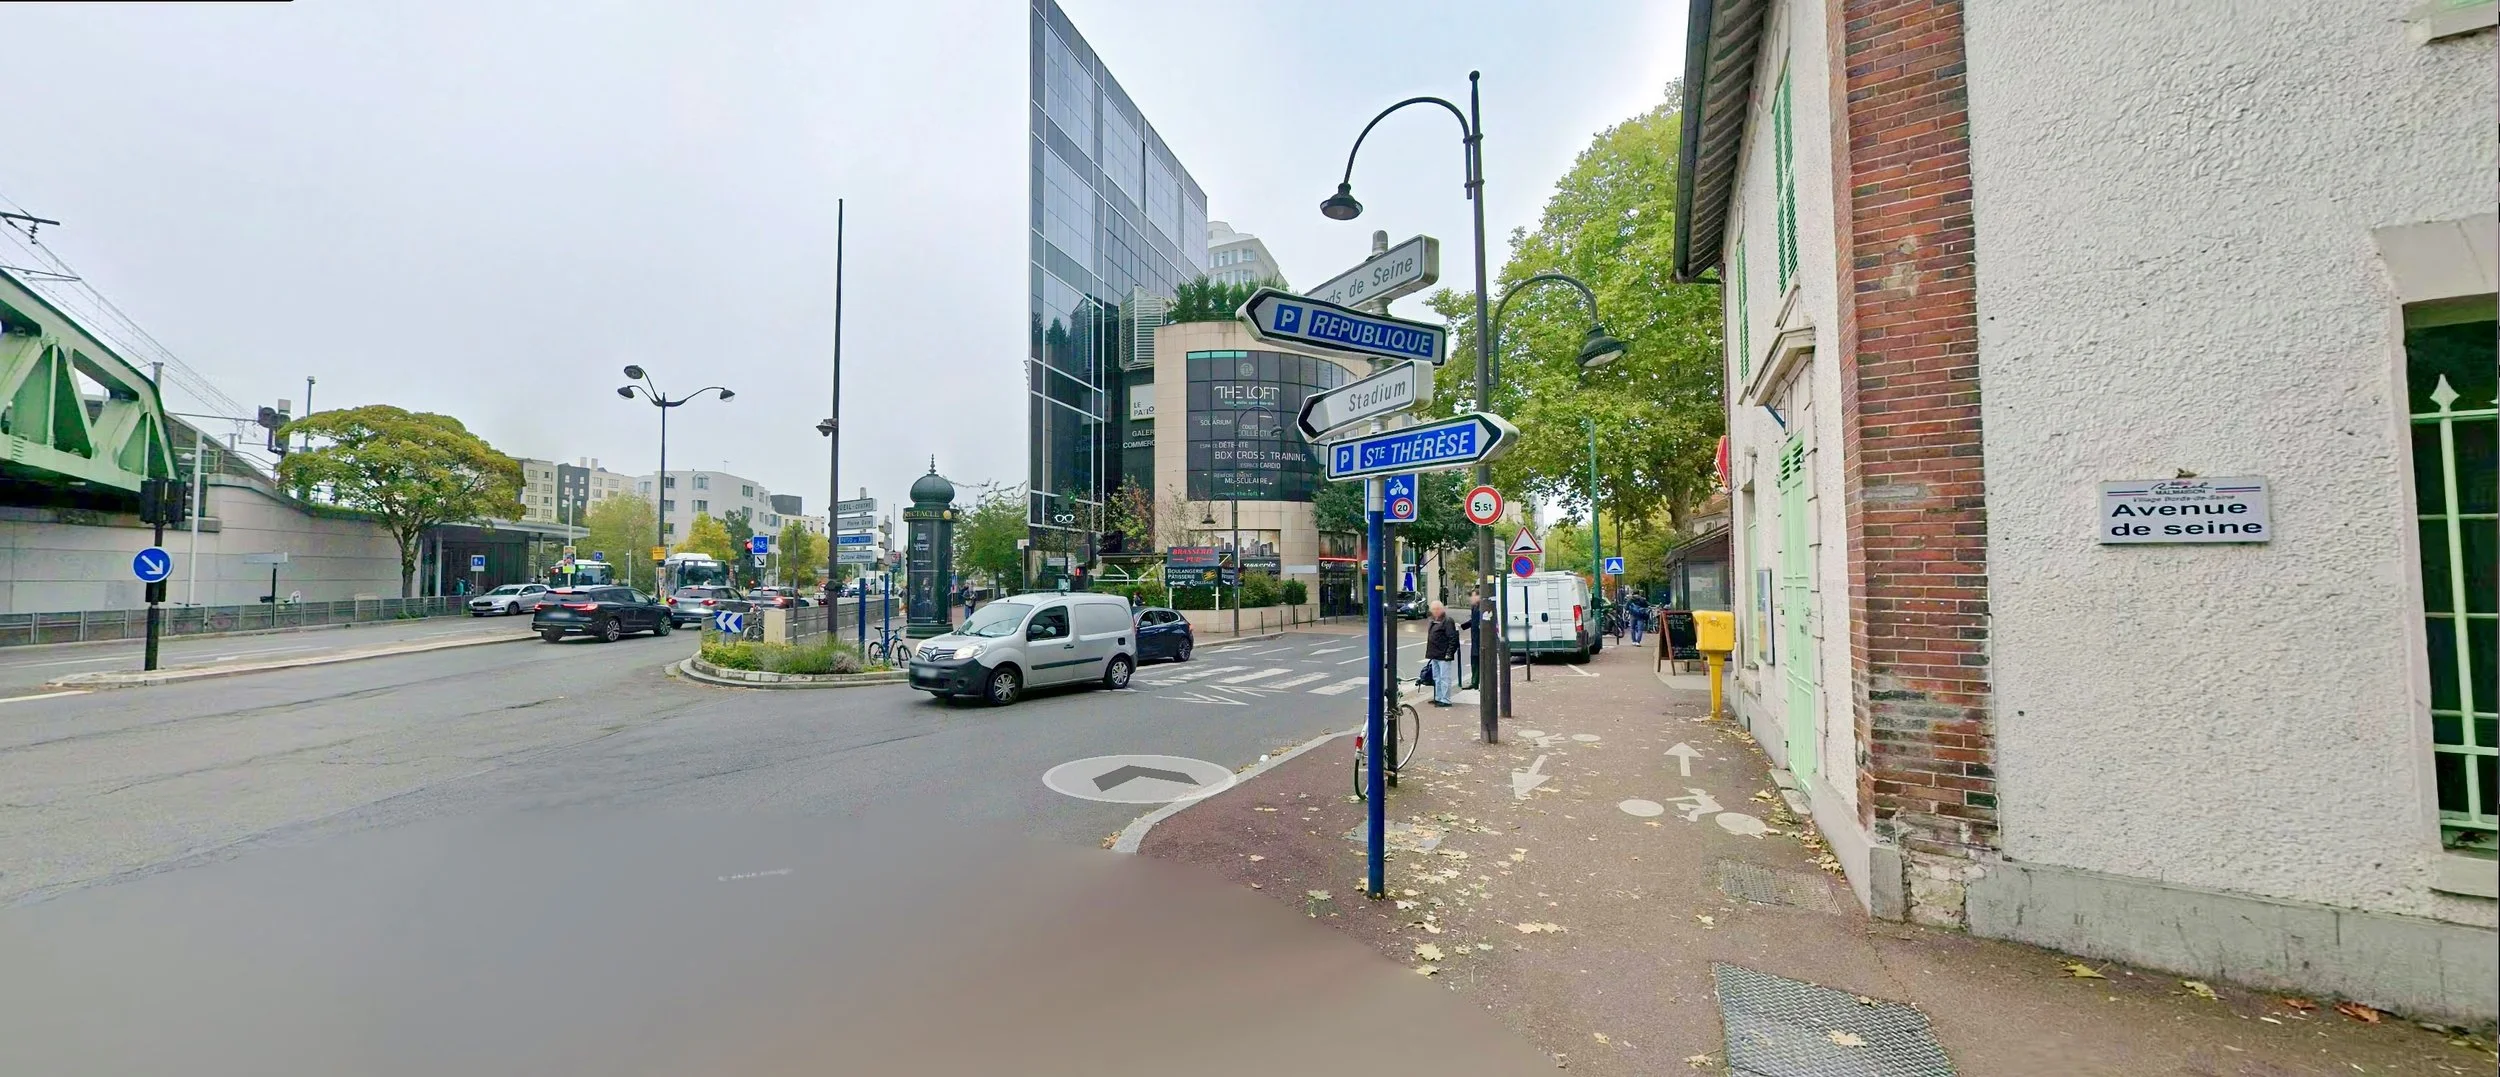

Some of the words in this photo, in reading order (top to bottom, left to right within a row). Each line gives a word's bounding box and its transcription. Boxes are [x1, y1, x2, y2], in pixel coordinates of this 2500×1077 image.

[1349, 279, 1364, 298] de
[1372, 257, 1413, 287] Seine
[1281, 309, 1296, 327] P
[1311, 314, 1431, 353] REPUBLIQUE
[1214, 386, 1244, 399] THE
[1246, 386, 1280, 400] LOFT
[1348, 378, 1406, 412] Stadium
[1133, 401, 1141, 409] LE
[1133, 406, 1155, 416] PATIO
[1131, 429, 1155, 437] GALER
[1122, 440, 1155, 449] COMMERC
[1340, 450, 1350, 468] P
[1391, 430, 1470, 463] THÉRÈSE
[1214, 451, 1233, 460] BOX
[1236, 451, 1265, 460] CROSS
[1270, 451, 1306, 462] TRAINING
[1397, 504, 1409, 512] 20
[2111, 502, 2249, 518] Avenue
[2110, 523, 2151, 537] de
[2163, 520, 2263, 535] seine
